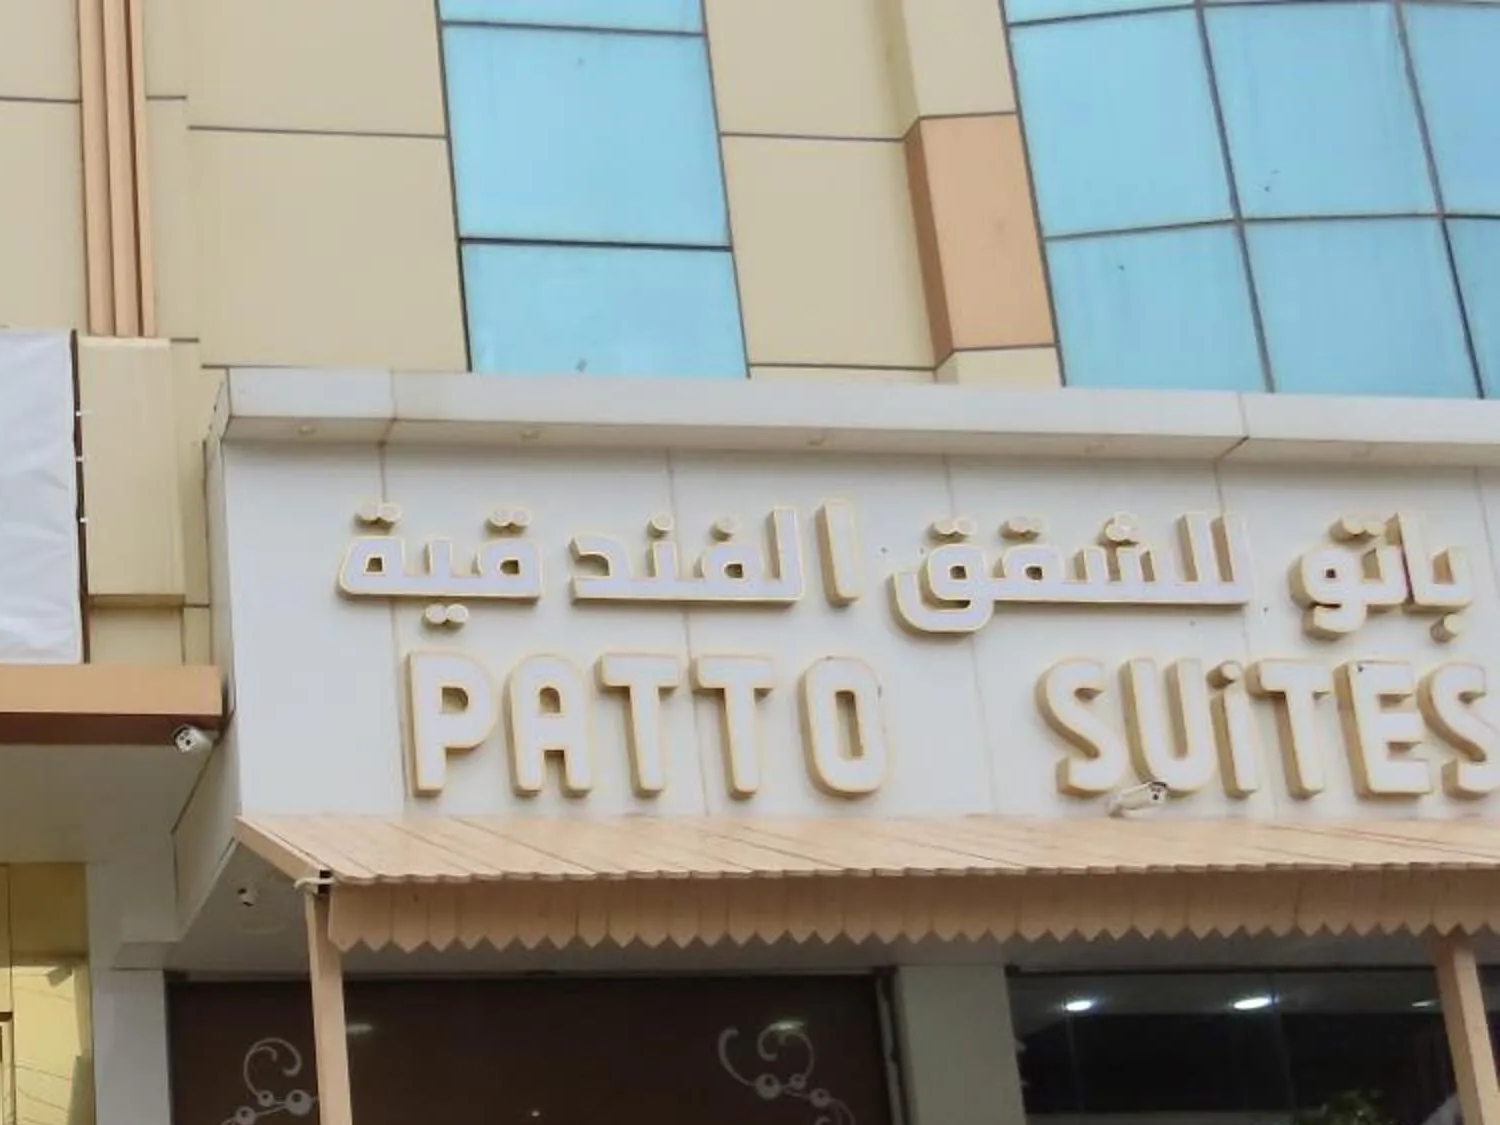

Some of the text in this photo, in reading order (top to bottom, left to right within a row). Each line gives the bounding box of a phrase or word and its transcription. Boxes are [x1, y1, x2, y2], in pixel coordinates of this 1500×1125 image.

[338, 499, 1473, 642] باتو للشقق الفندقية
[405, 650, 887, 797] PATTO
